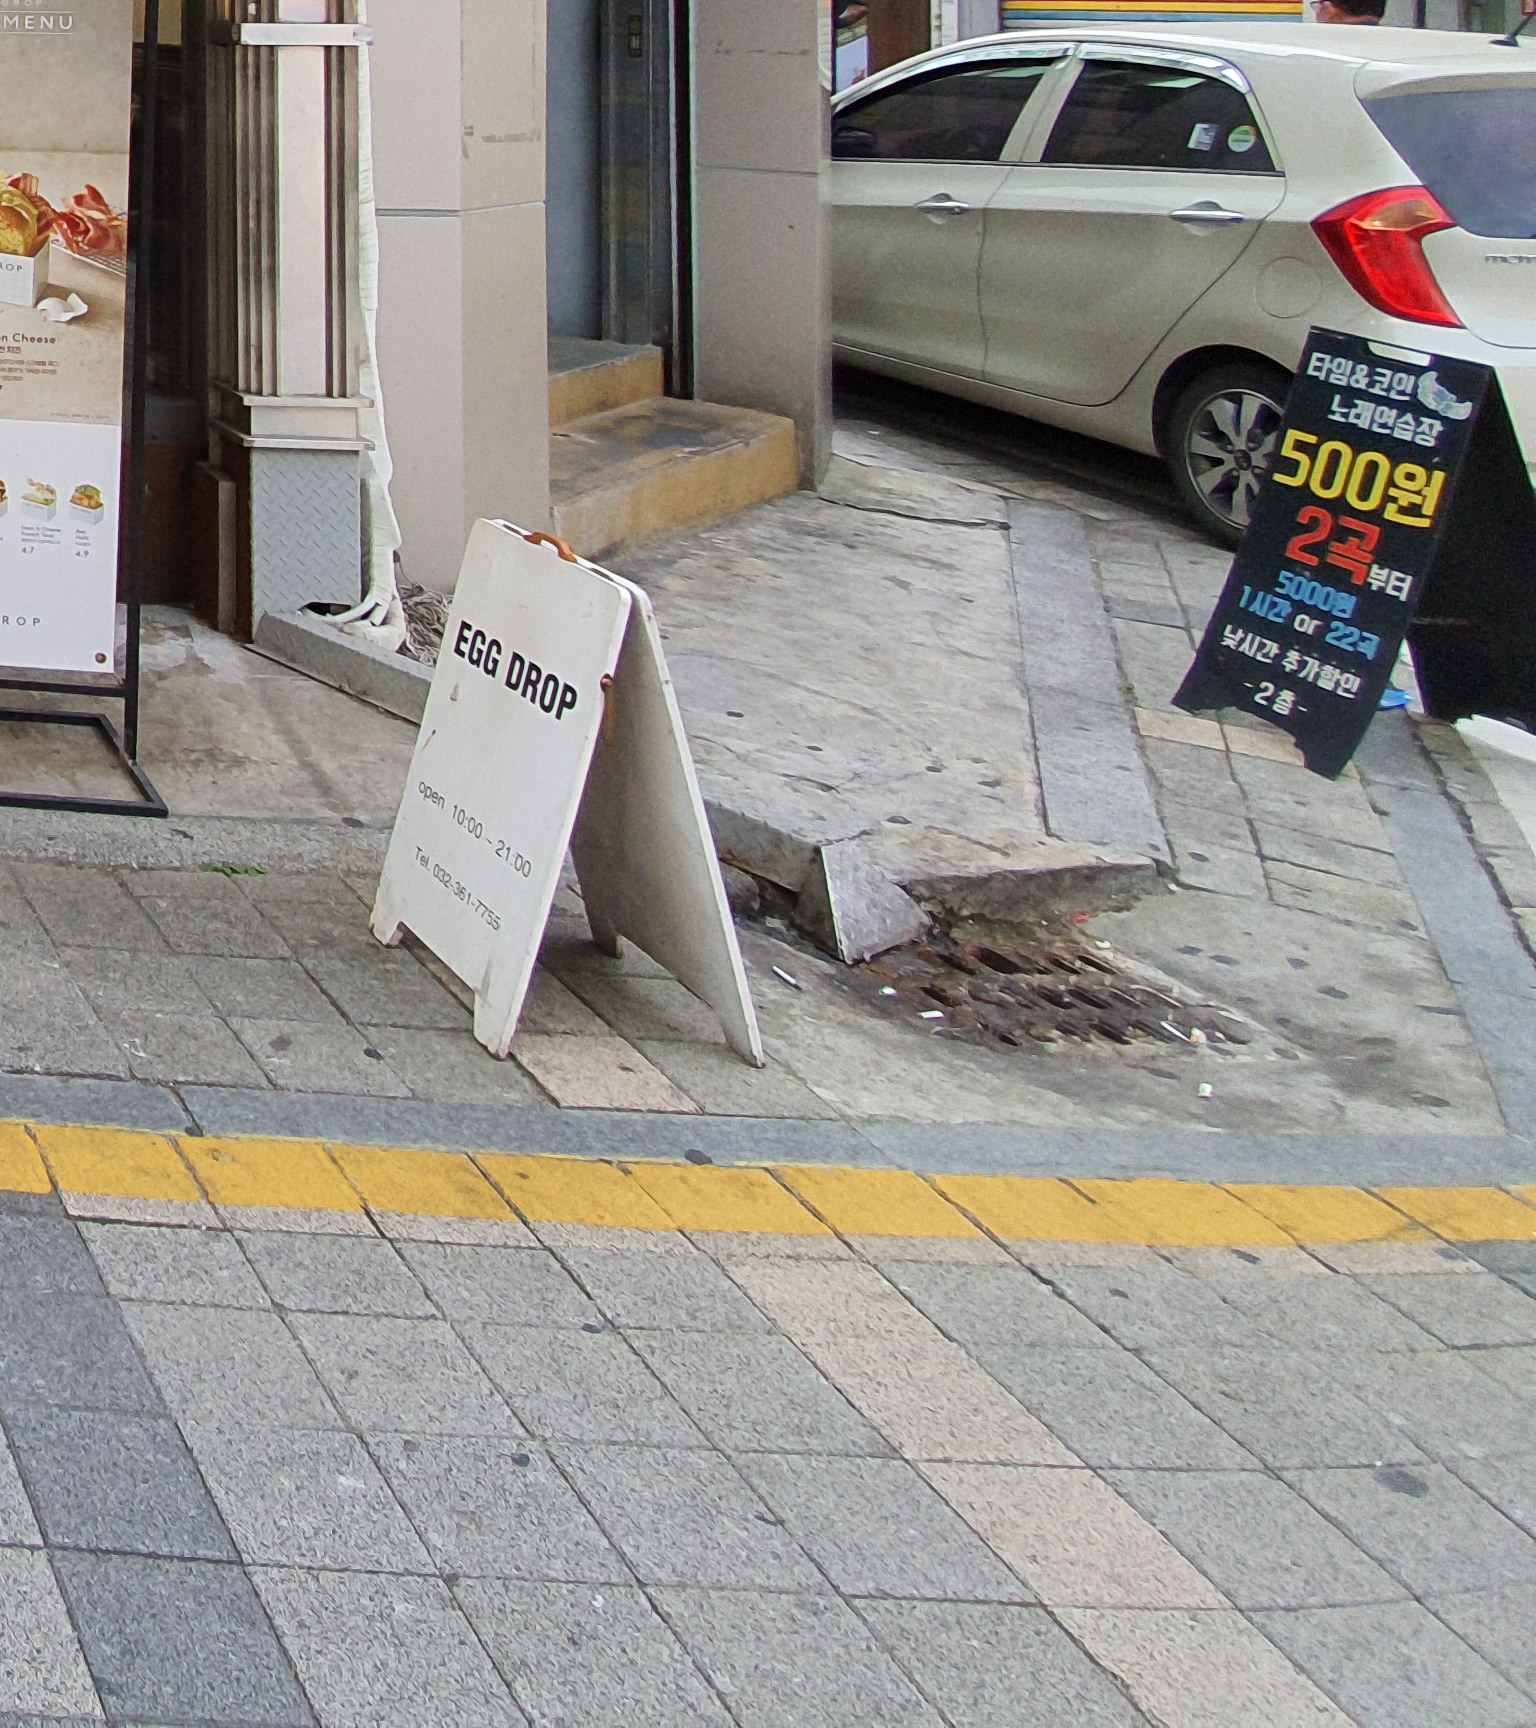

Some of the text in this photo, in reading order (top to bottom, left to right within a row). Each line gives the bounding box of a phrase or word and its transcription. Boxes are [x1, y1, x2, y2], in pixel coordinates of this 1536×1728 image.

[3, 15, 73, 30] MENU
[12, 333, 56, 344] Cheese
[1306, 351, 1416, 401] 타임&코인
[1327, 394, 1444, 447] 노래연습장
[1271, 427, 1448, 528] 500원
[1285, 505, 1414, 602] 2곡 부터
[1239, 585, 1381, 661] 1시간 or 22곡
[1275, 570, 1358, 619] 5000원
[453, 619, 579, 721] EGG DROP
[1220, 624, 1364, 699] 낮시간 추가할인
[418, 780, 446, 810] open
[451, 803, 484, 841] 10:00
[495, 839, 533, 879] 21:00
[432, 861, 503, 932] 032-361-7755
